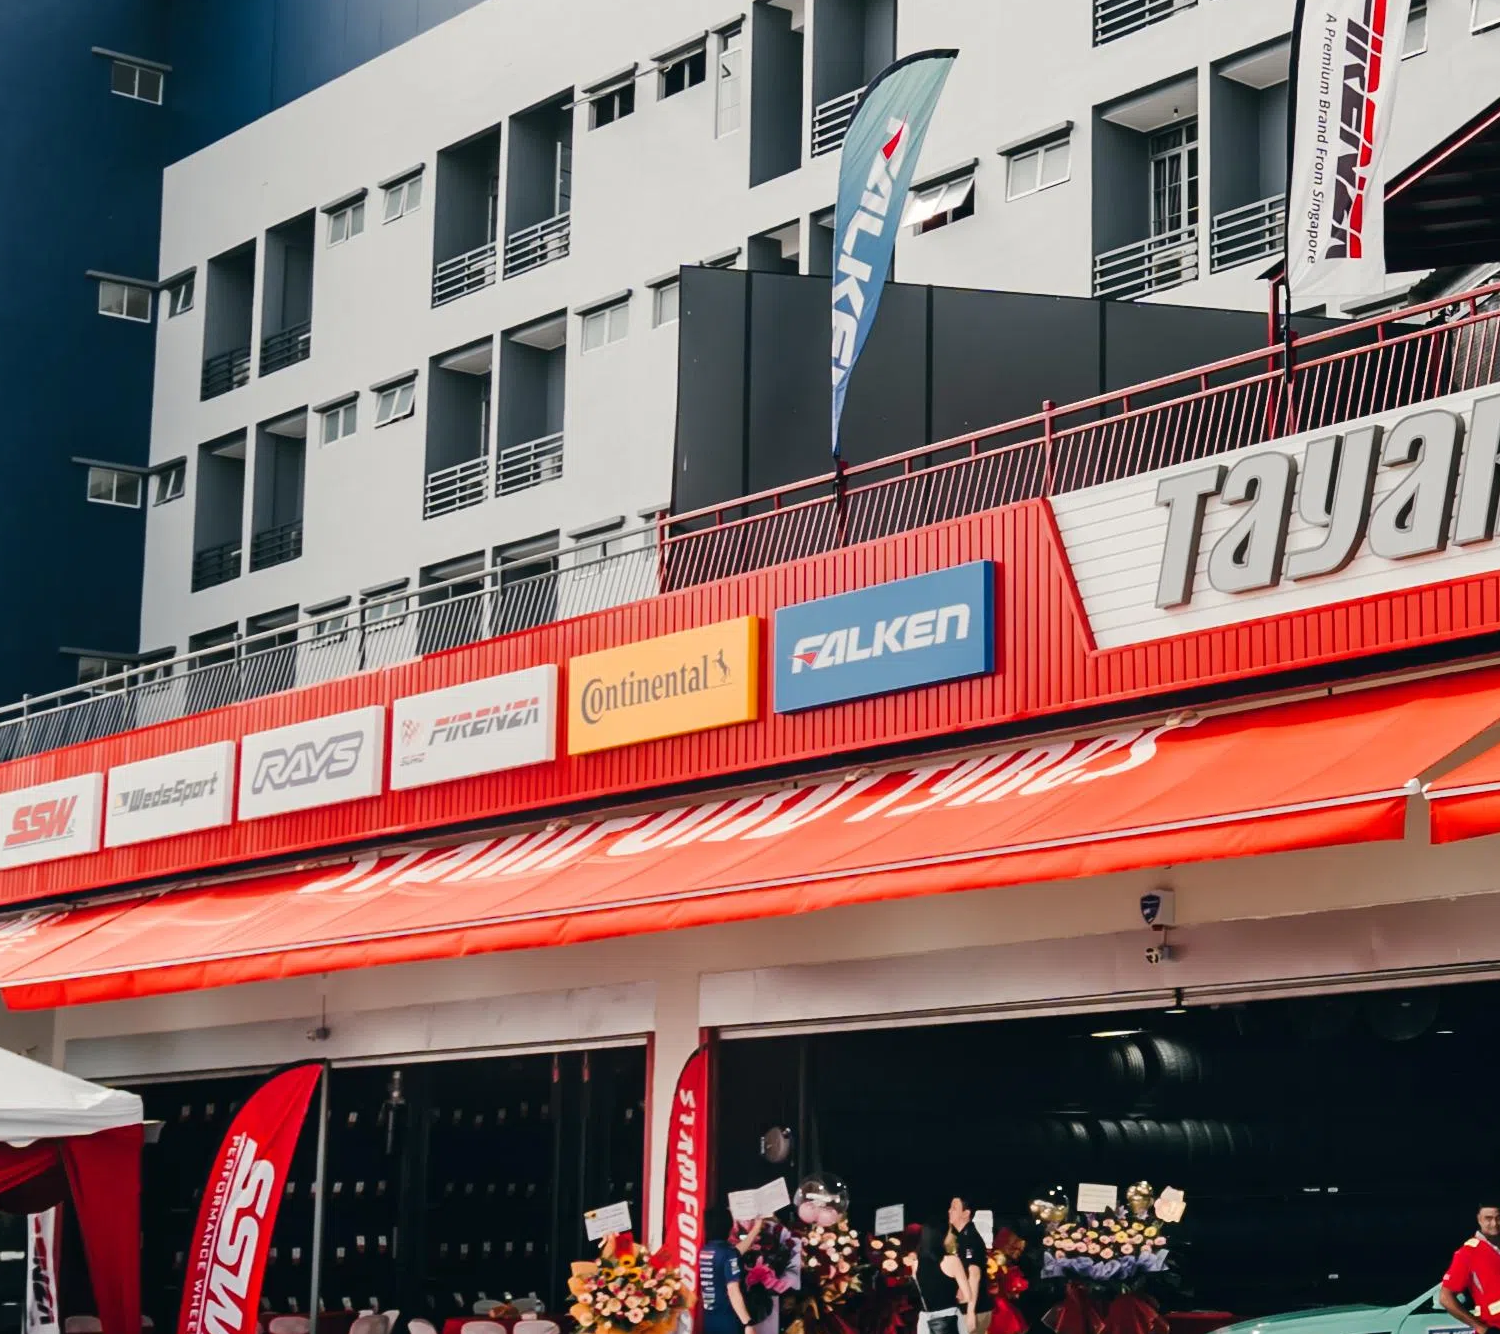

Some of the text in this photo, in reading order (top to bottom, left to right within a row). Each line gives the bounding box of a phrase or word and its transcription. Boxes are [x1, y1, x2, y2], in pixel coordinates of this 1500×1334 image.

[1306, 14, 1337, 265] A Premium Brand From Singapore
[789, 603, 970, 674] FALKEN
[429, 697, 539, 745] FIRENZA
[581, 655, 709, 724] Continental
[128, 771, 218, 813] WedsSport
[252, 730, 363, 794] RAYS
[3, 795, 78, 848] SSW
[197, 1135, 240, 1271] PERFORMANCE
